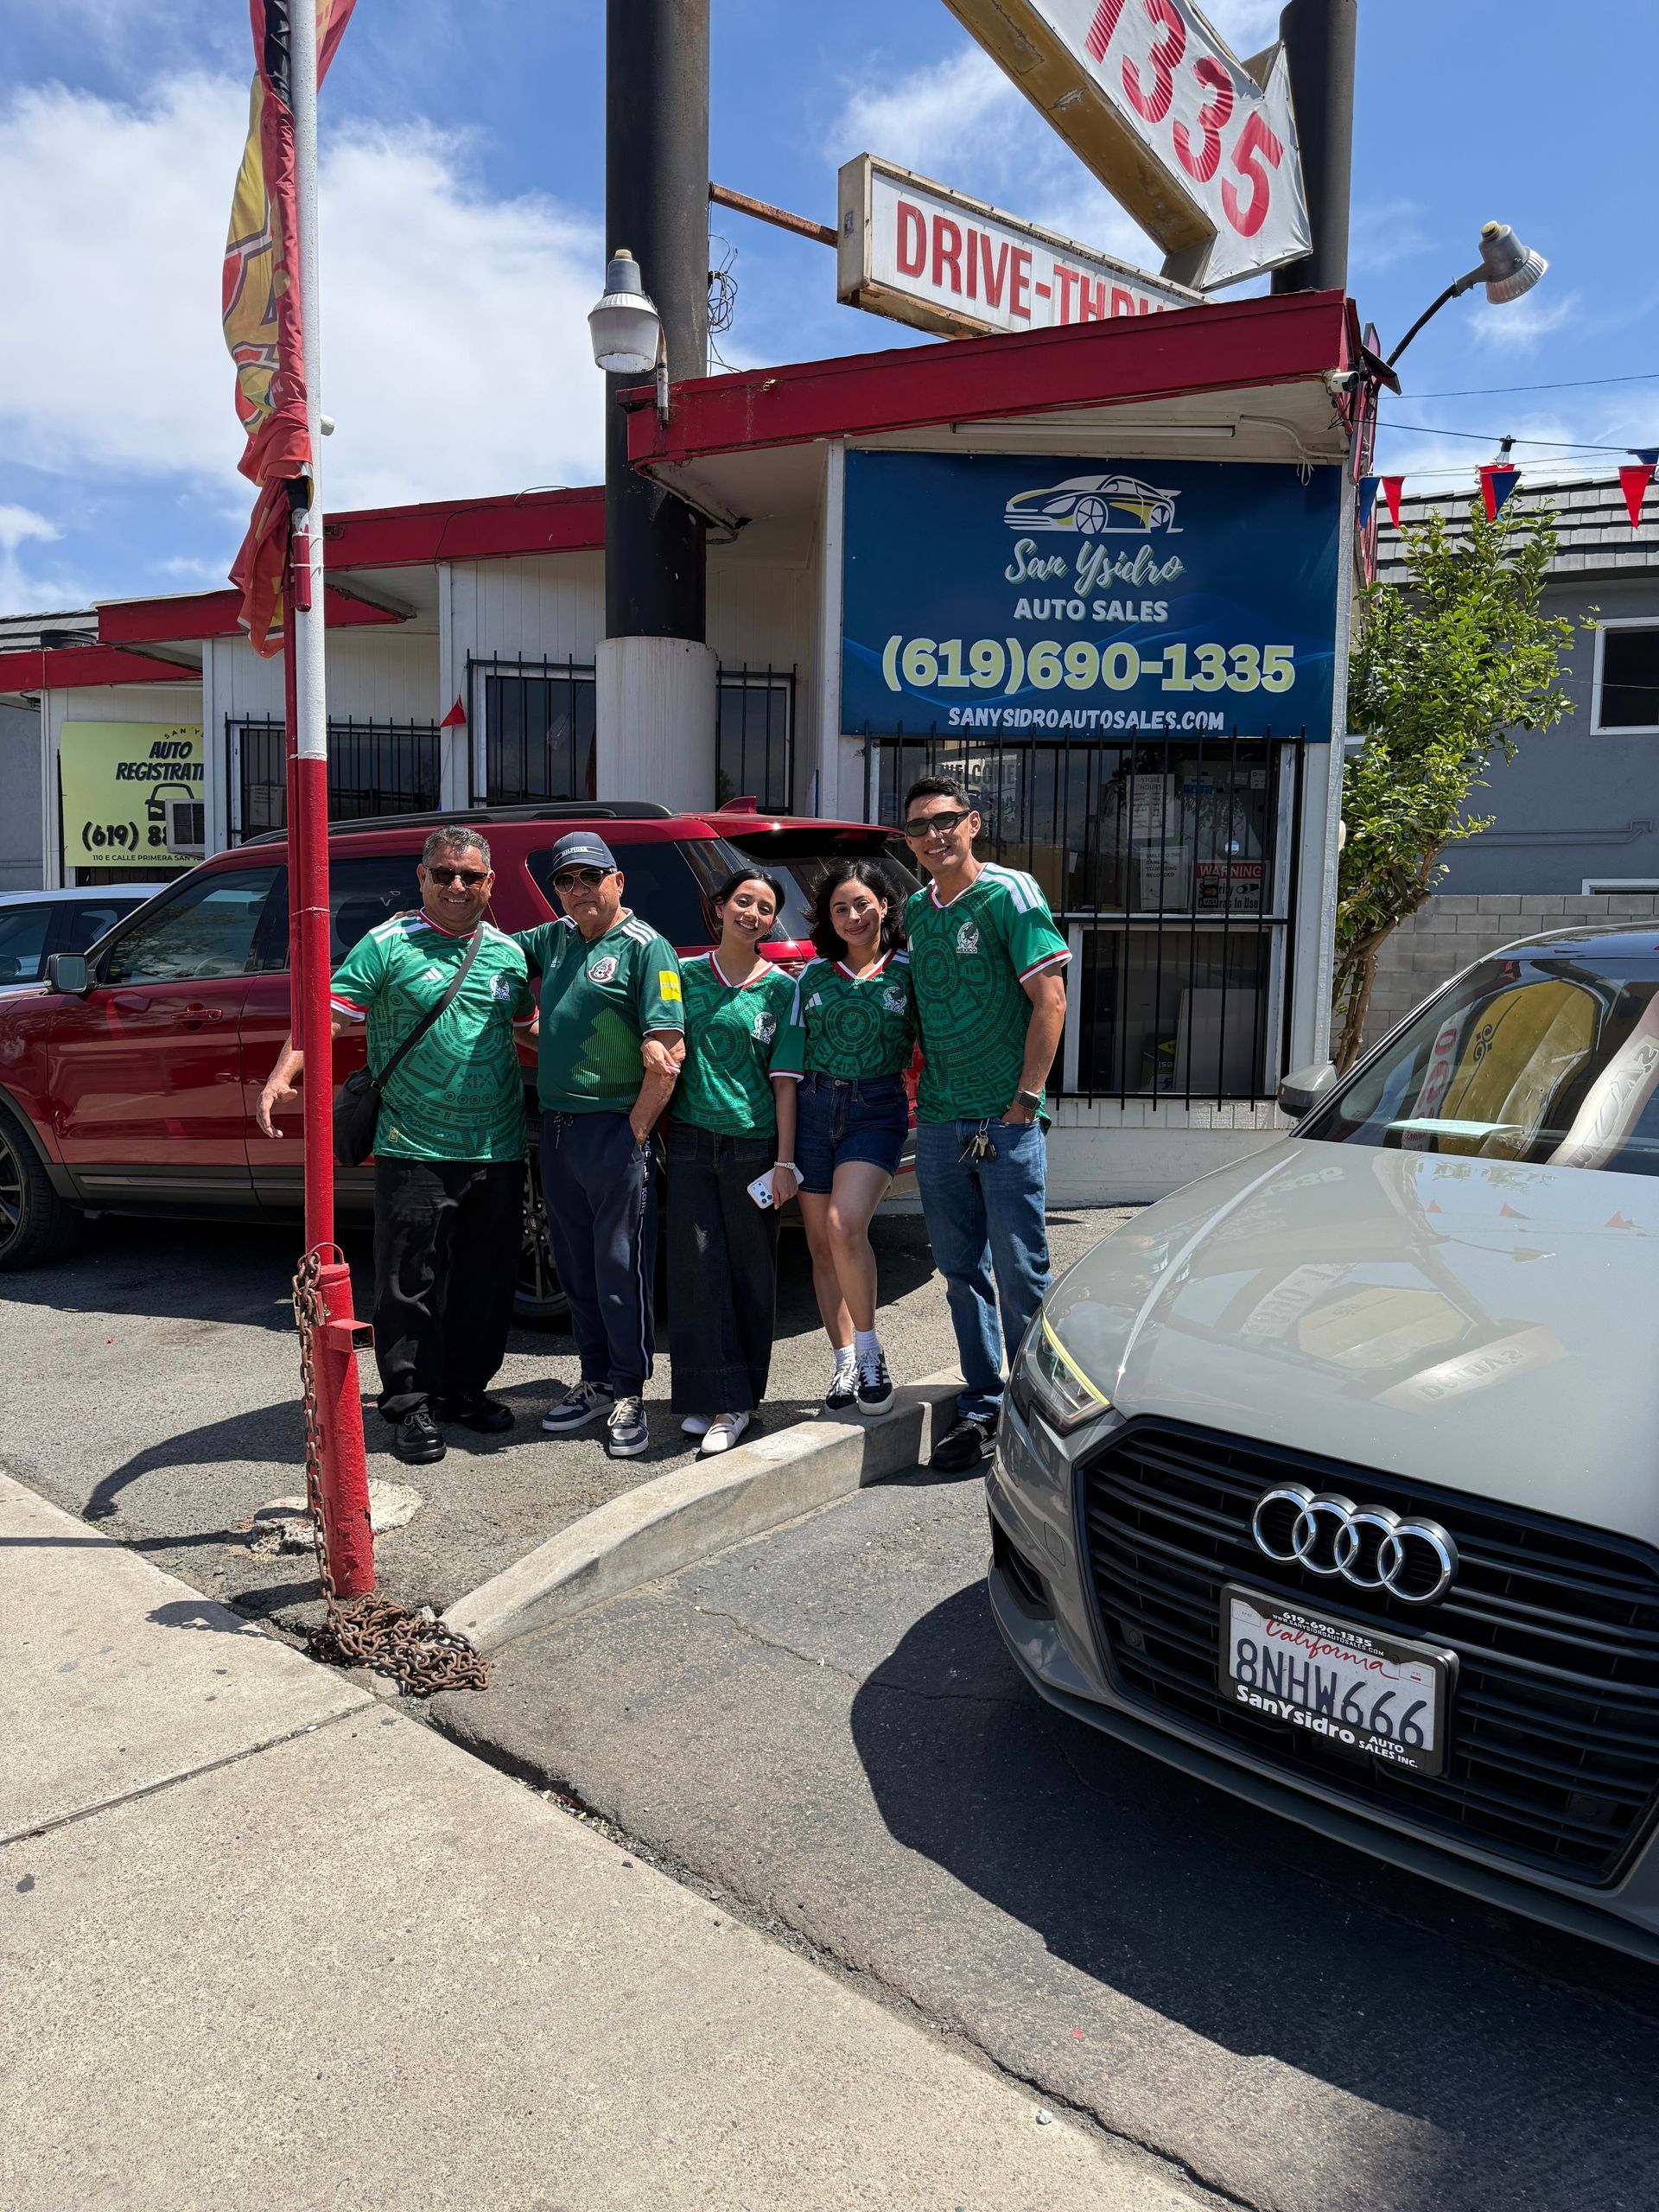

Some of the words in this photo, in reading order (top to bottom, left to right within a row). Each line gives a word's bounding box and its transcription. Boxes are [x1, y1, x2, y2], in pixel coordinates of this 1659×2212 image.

[1005, 537, 1070, 585] San
[1074, 540, 1187, 598] Ysidro
[1013, 598, 1086, 621] AUTO
[1092, 600, 1169, 623] SALES
[882, 635, 1296, 695] (619)690-1335
[164, 728, 186, 739] SAN
[947, 706, 1225, 731] SANYSIDROAUTOSALES.COM
[149, 741, 193, 760] AUTO
[82, 821, 139, 852] (619)
[1235, 897, 1242, 908] In
[1244, 897, 1259, 908] Use
[1272, 1614, 1384, 1656] WWW.SANYSIDROAUTOSALES.COM
[1282, 1611, 1372, 1648] 619-690-1335
[1266, 1618, 1399, 1680] California
[1236, 1637, 1427, 1749] 8NHW666
[1358, 1739, 1395, 1761] SALES
[1397, 1755, 1419, 1768] INC.
[1369, 1735, 1405, 1755] AUTO
